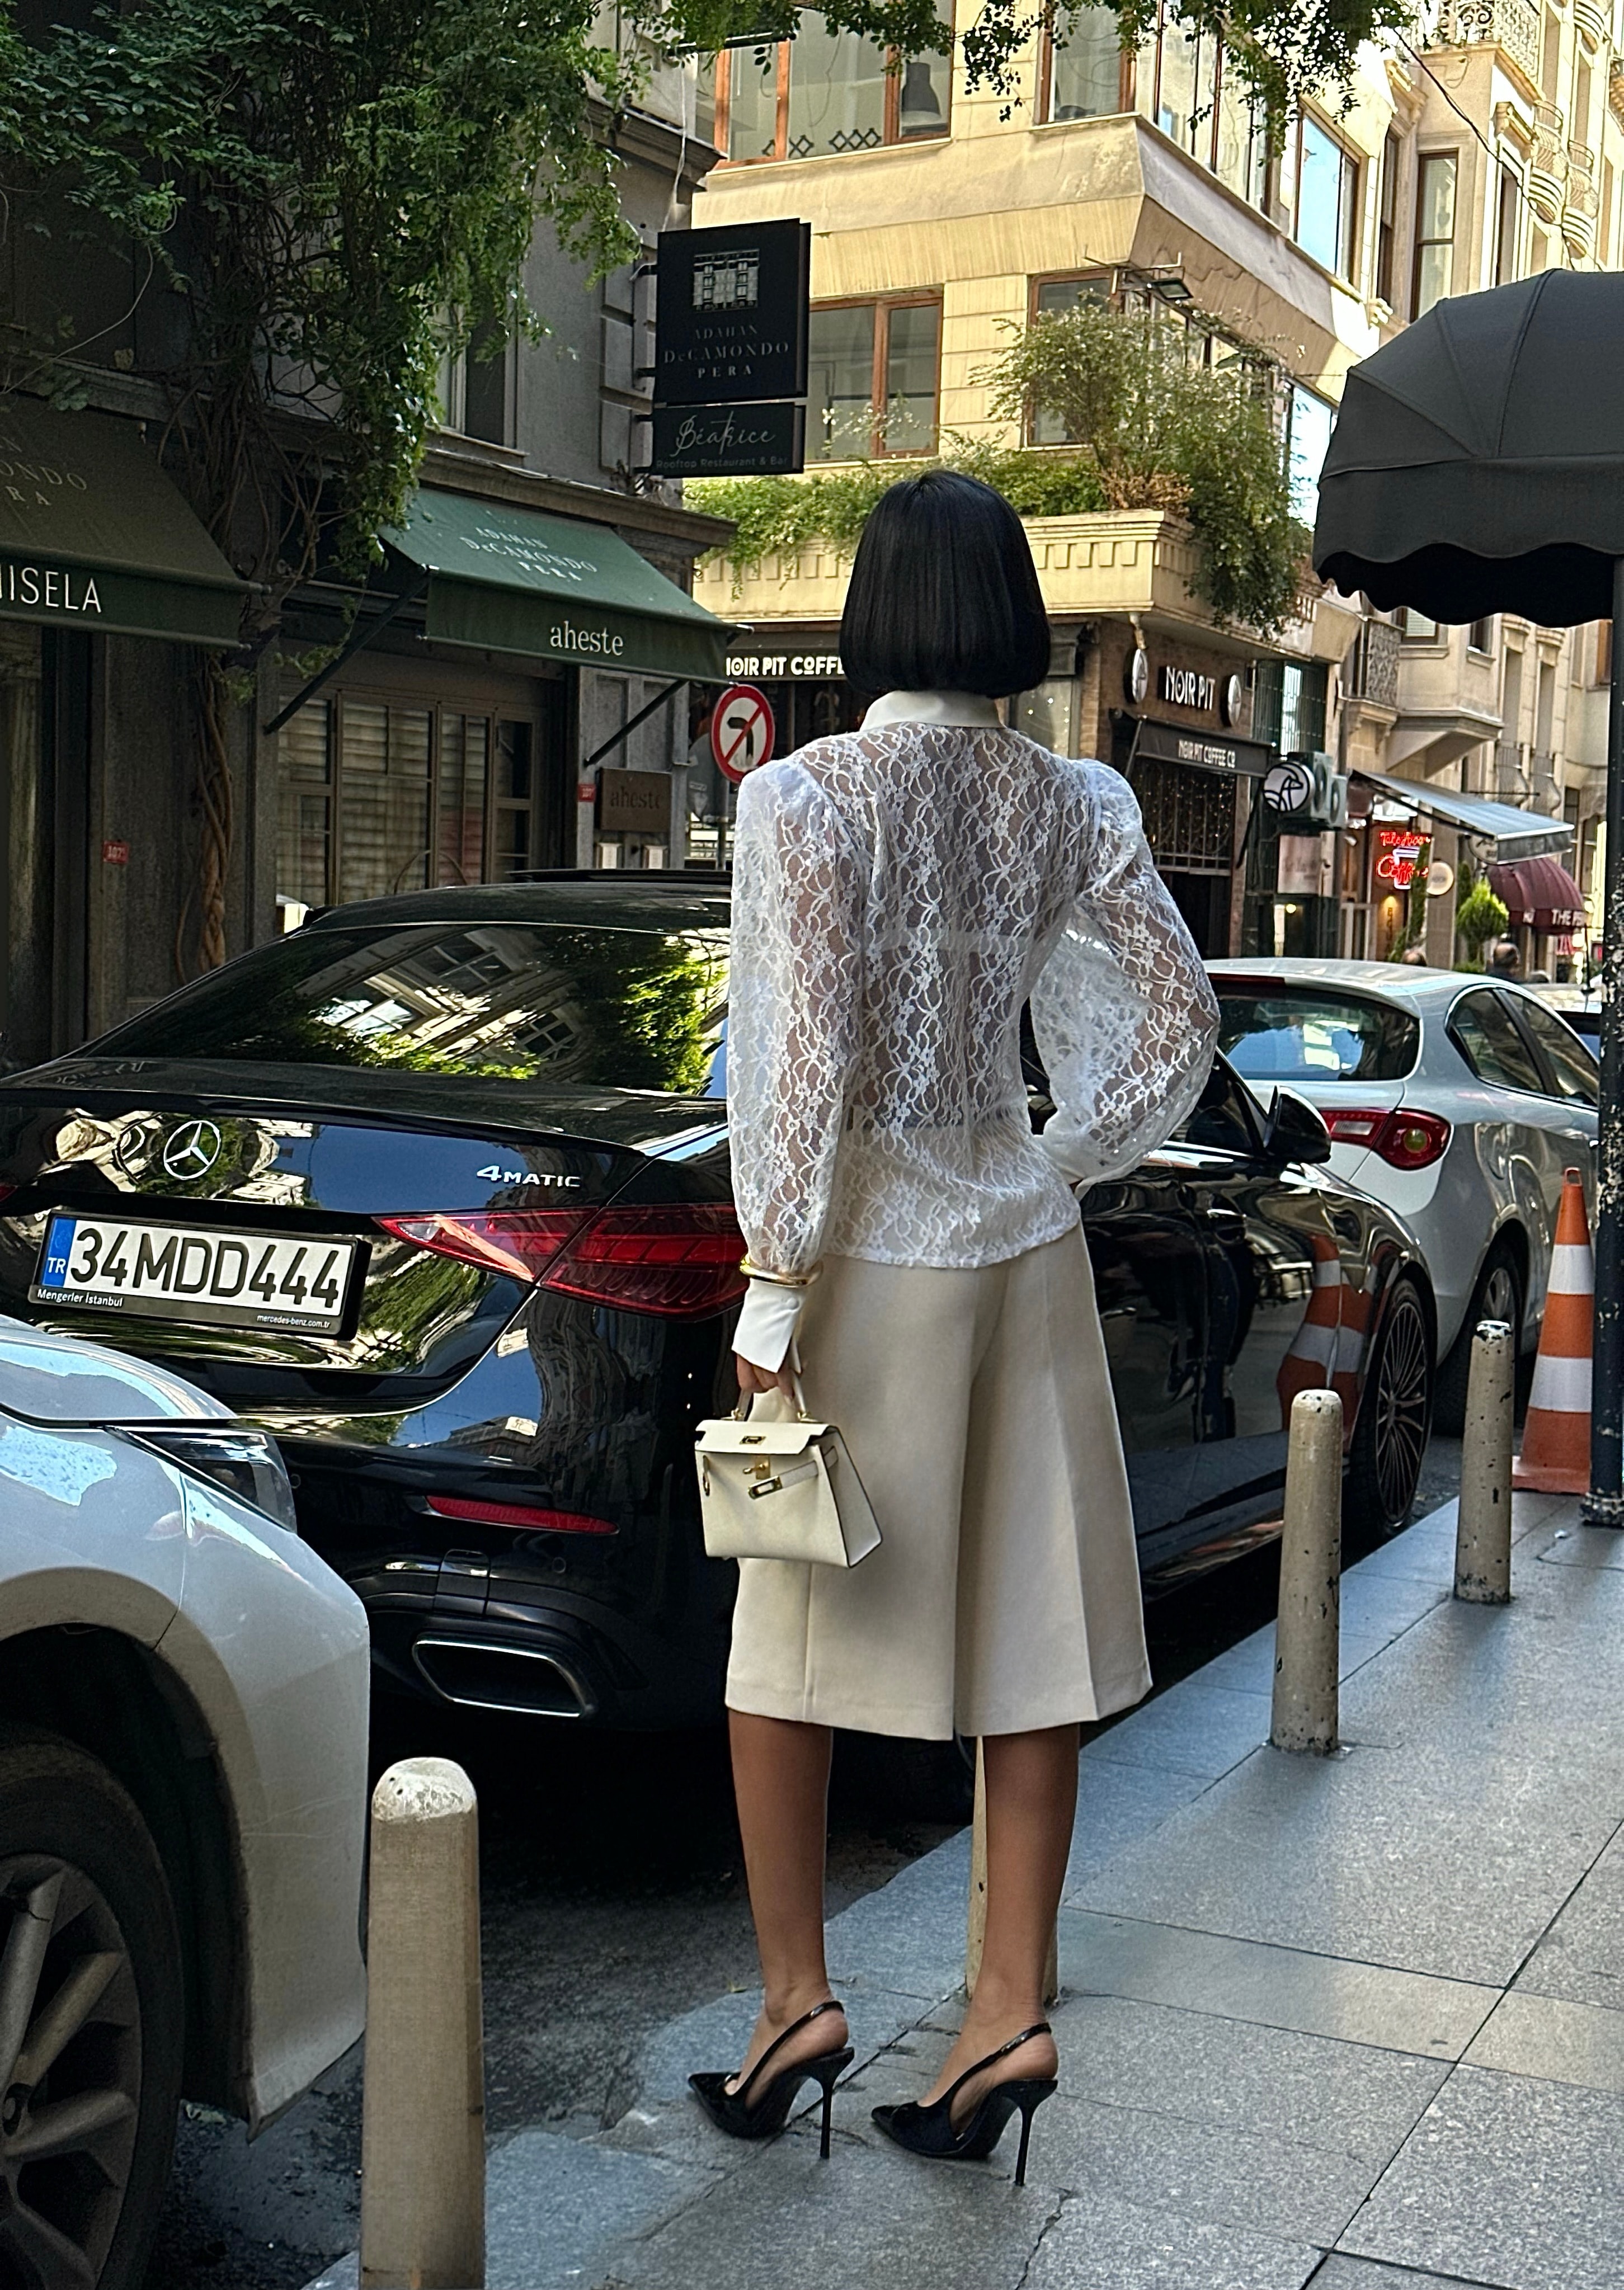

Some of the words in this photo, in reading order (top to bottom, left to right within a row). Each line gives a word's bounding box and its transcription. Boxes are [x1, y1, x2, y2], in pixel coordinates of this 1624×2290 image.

[698, 365, 752, 379] PERA
[656, 460, 696, 469] Rooftop
[701, 458, 755, 467] Restaurant
[550, 620, 624, 656] aheste
[762, 657, 786, 676] PIT
[1165, 666, 1196, 706] NOIR
[1198, 675, 1216, 711] PIT
[477, 1165, 581, 1187] 4MATIC
[48, 1256, 66, 1275] TR
[70, 1228, 339, 1308] 34MDD444
[37, 1288, 83, 1303] Mengerler
[257, 1314, 331, 1328] mercedes-benz.com.tr
